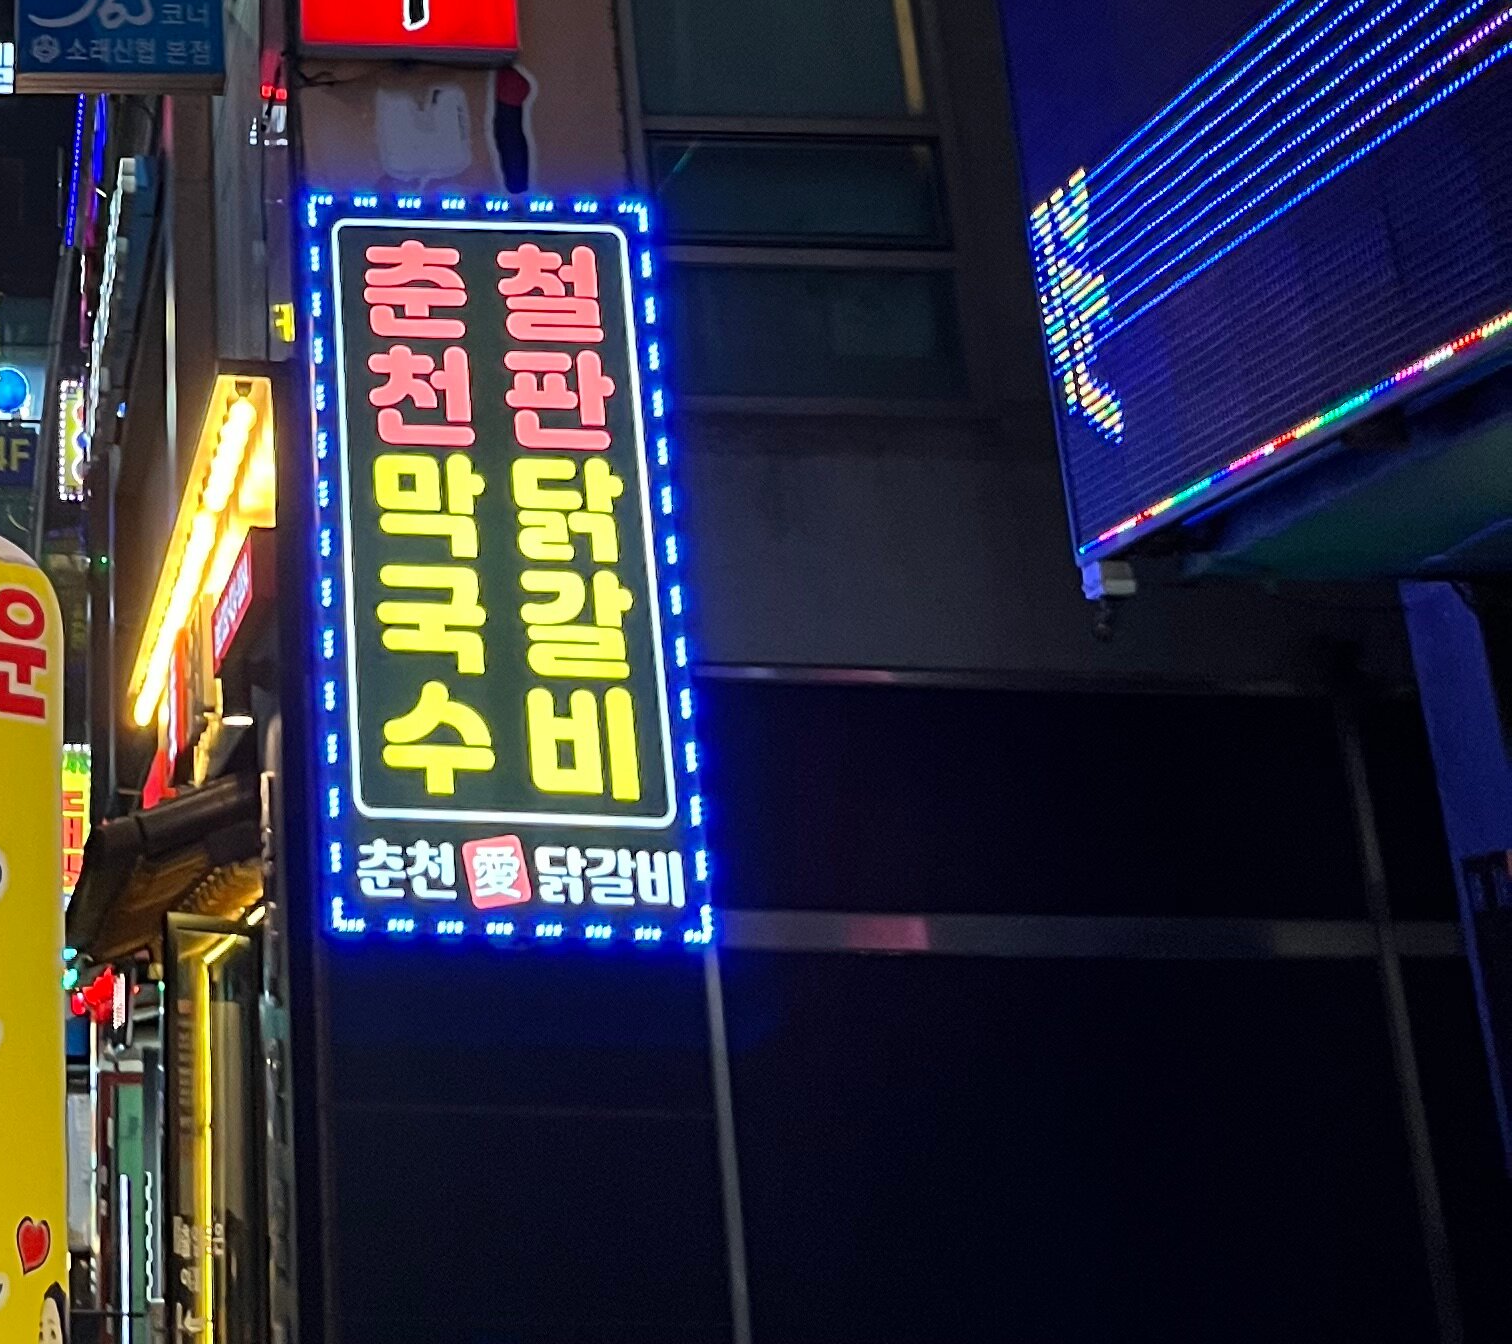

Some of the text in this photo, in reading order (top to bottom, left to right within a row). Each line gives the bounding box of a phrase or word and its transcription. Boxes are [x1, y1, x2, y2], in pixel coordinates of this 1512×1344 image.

[159, 3, 210, 28] 코너
[65, 38, 212, 66] 소래신협 본점
[356, 838, 458, 900] 춘천
[534, 845, 686, 909] 닭갈비
